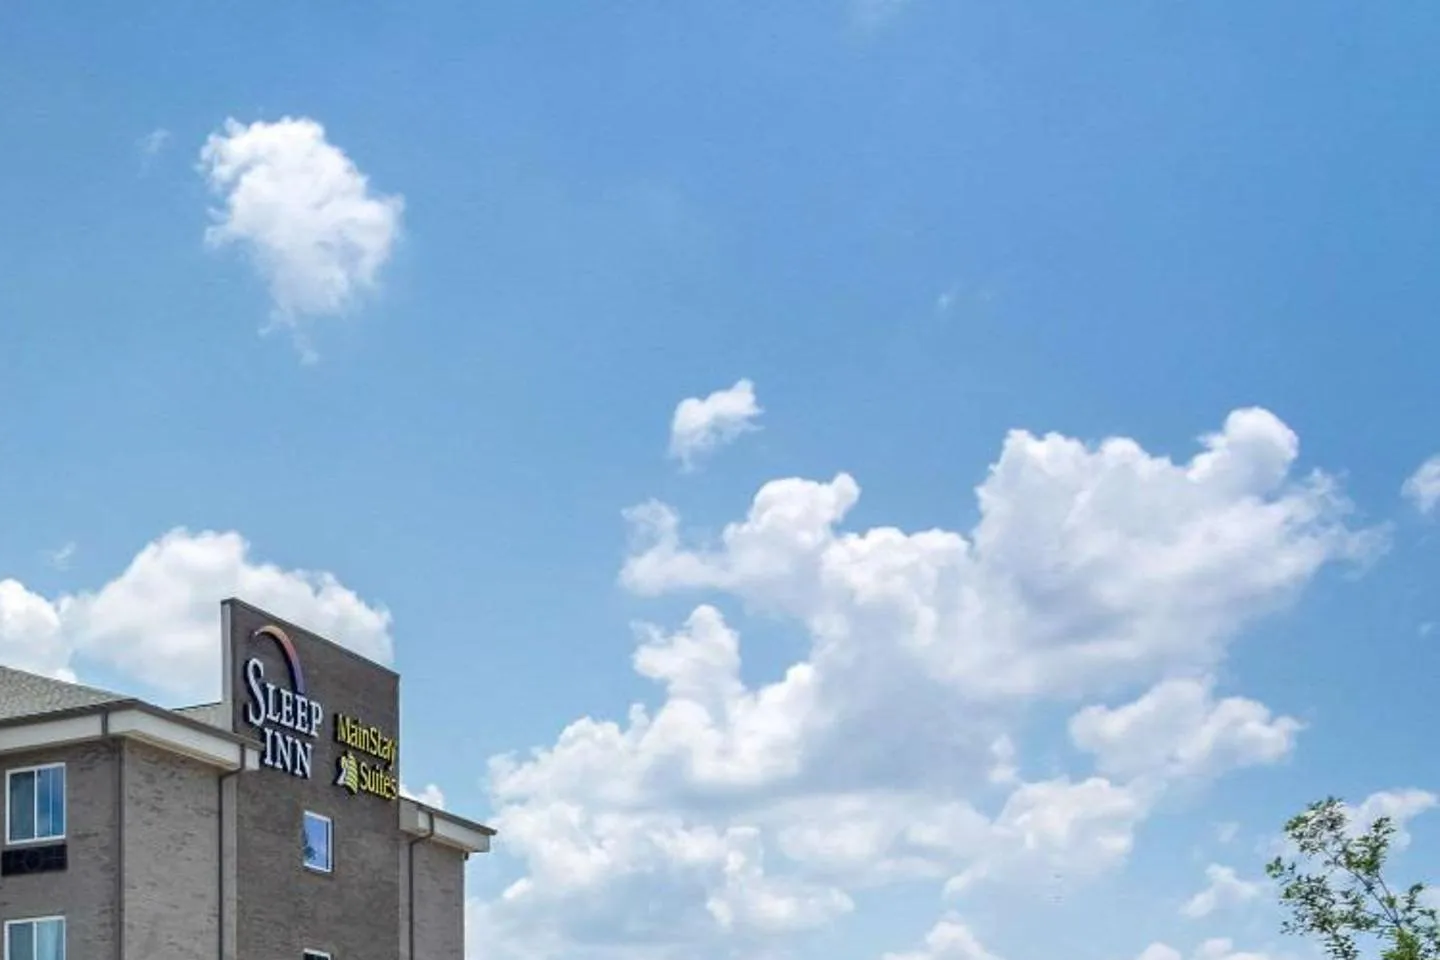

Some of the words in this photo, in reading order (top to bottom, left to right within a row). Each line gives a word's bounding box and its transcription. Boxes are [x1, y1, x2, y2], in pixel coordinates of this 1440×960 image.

[247, 658, 323, 737] SLEEP
[264, 728, 312, 778] INN
[336, 713, 396, 770] MainStay
[360, 762, 398, 799] Suites
